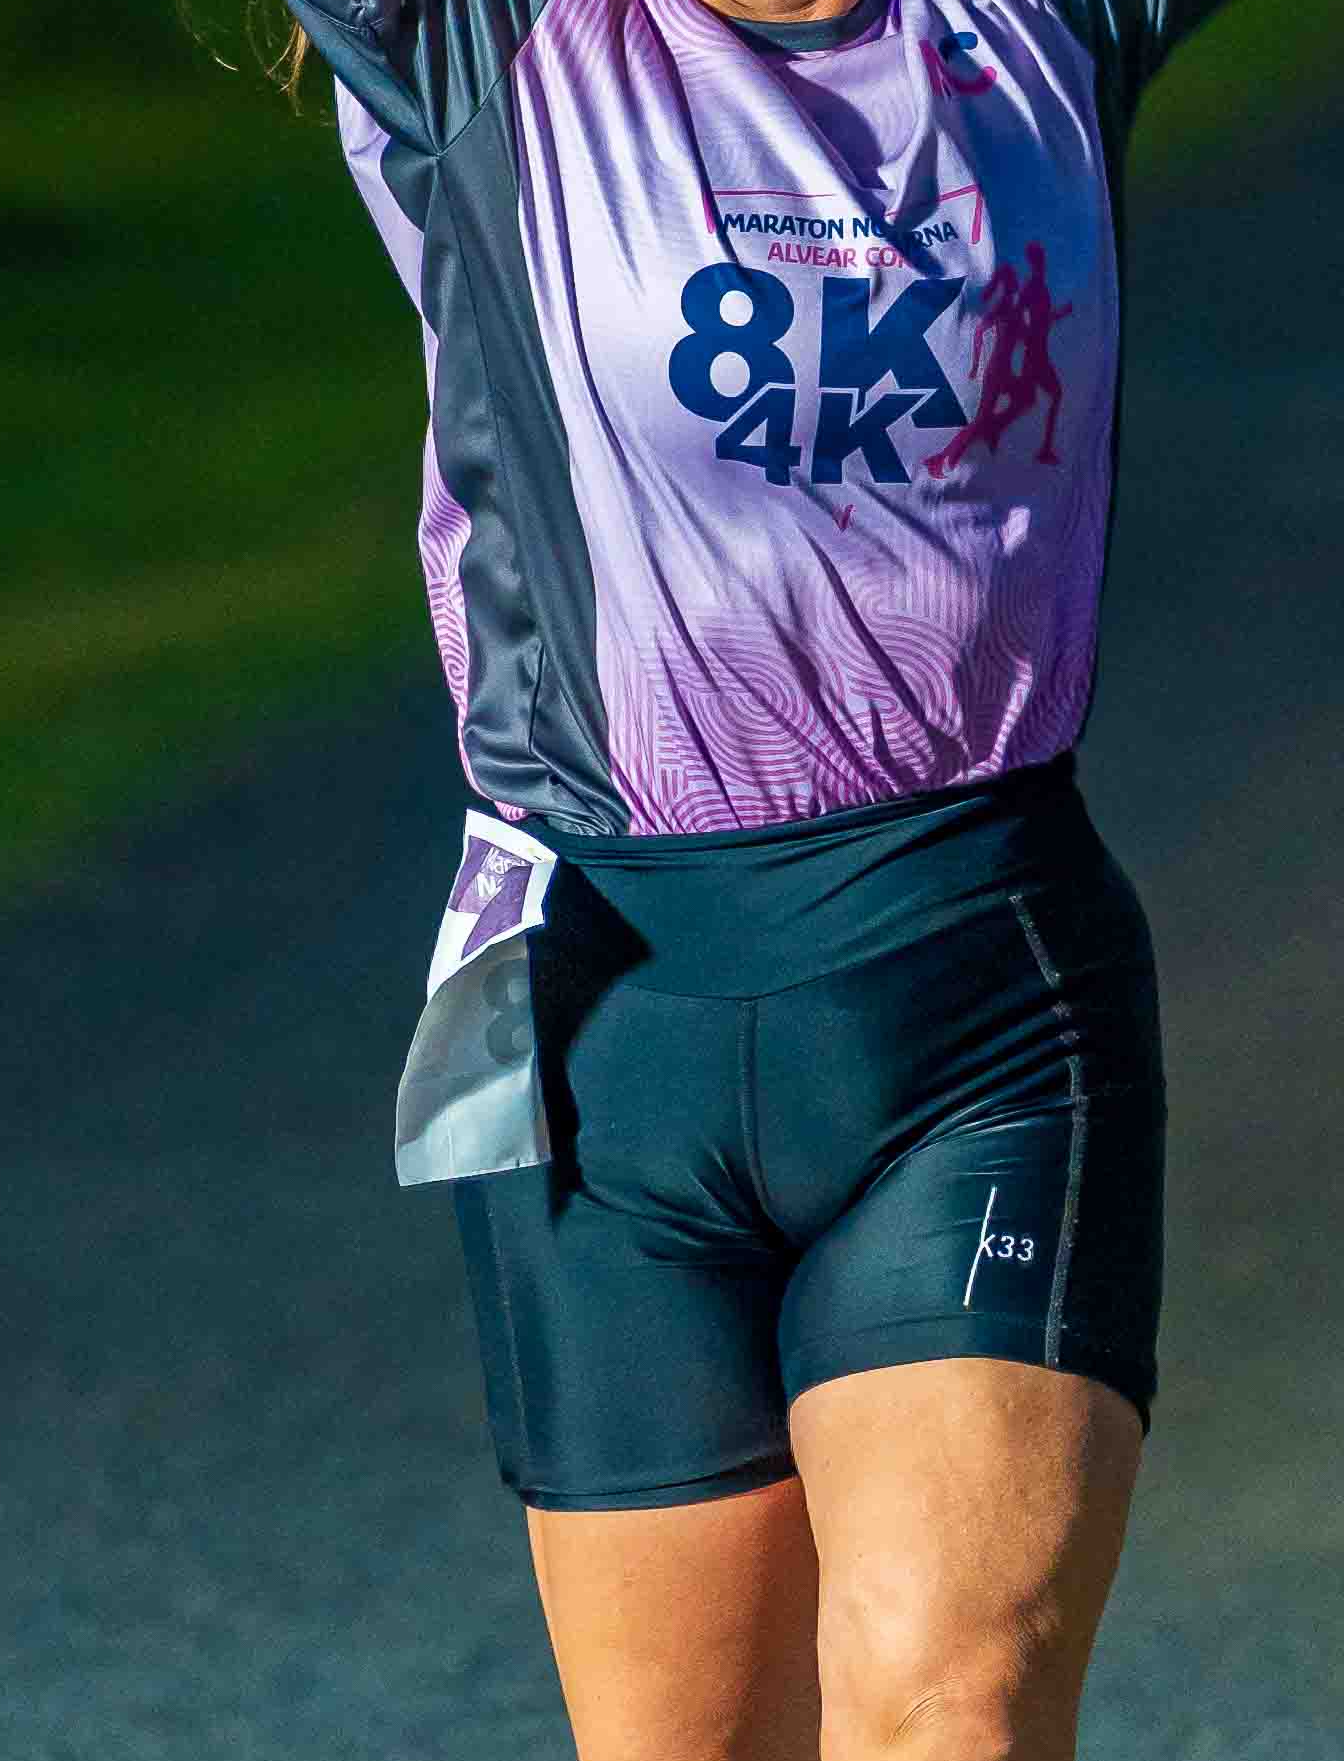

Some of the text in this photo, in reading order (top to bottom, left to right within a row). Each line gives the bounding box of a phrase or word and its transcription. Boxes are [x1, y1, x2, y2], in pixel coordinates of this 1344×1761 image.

[723, 213, 844, 239] MARATON
[768, 242, 856, 268] ALVEAR
[714, 386, 928, 487] 4K
[980, 1233, 1035, 1262] K33
